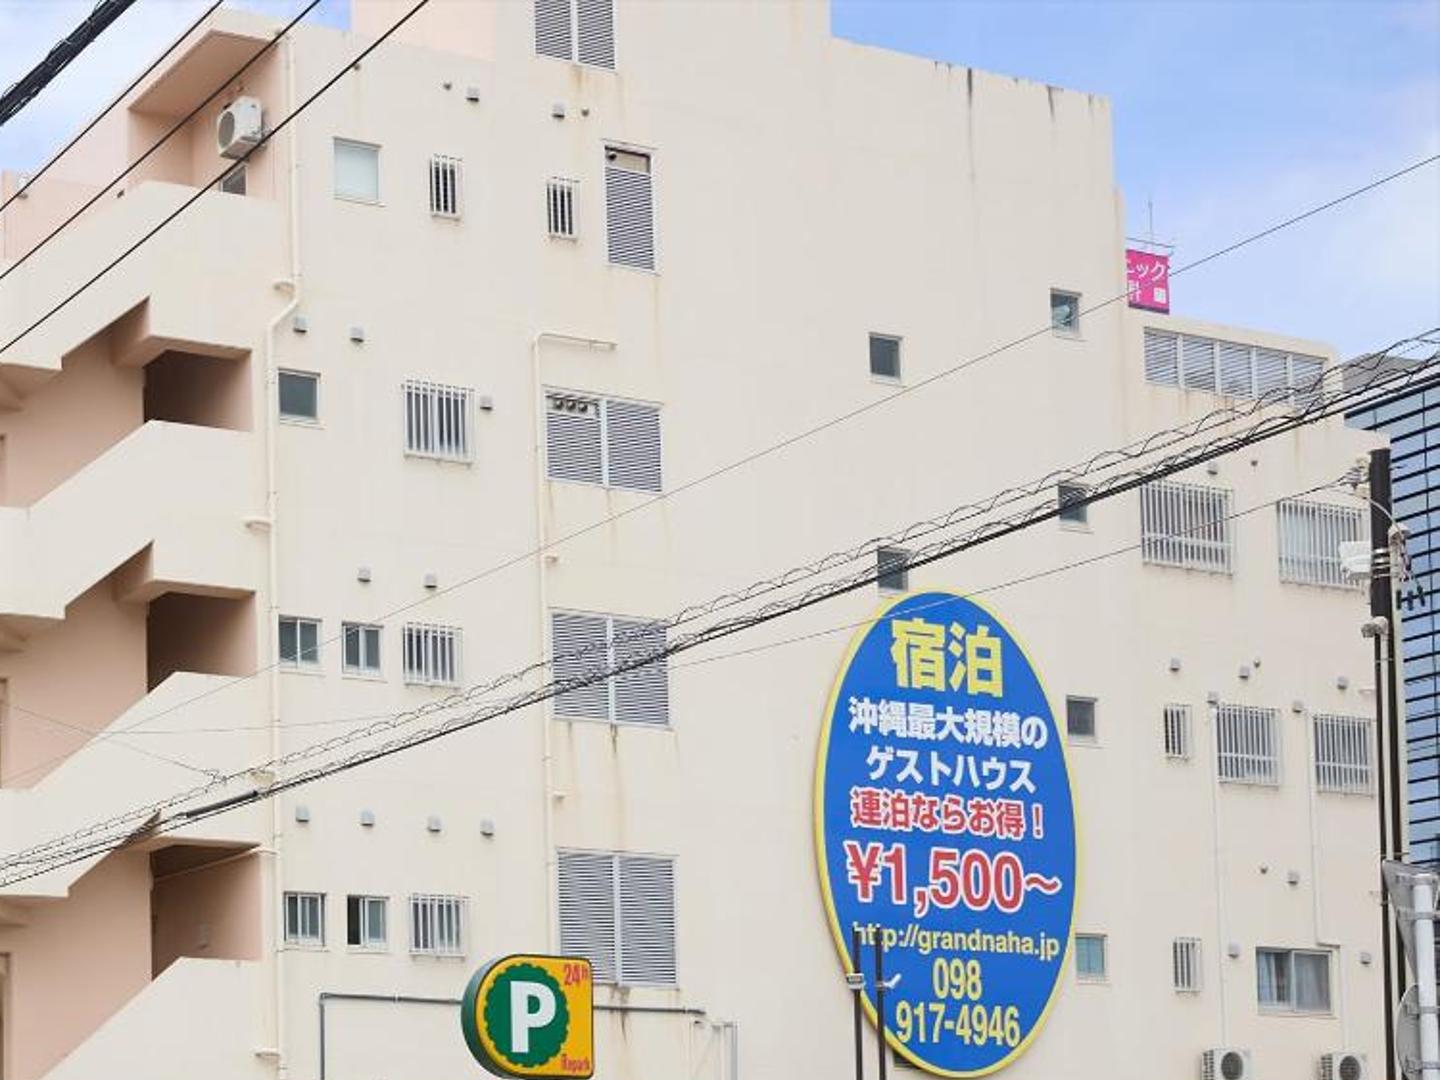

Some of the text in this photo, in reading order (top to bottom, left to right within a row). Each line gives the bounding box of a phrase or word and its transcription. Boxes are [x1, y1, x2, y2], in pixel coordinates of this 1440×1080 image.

[890, 617, 1003, 698] 宿泊
[848, 696, 1048, 750] 沖縄最大規模の
[866, 745, 1037, 794] ゲストハウス
[849, 786, 1046, 840] 連泊ならお得!
[932, 957, 983, 1000] 098
[511, 980, 557, 1054] P
[896, 1000, 1020, 1047] 917-4946
